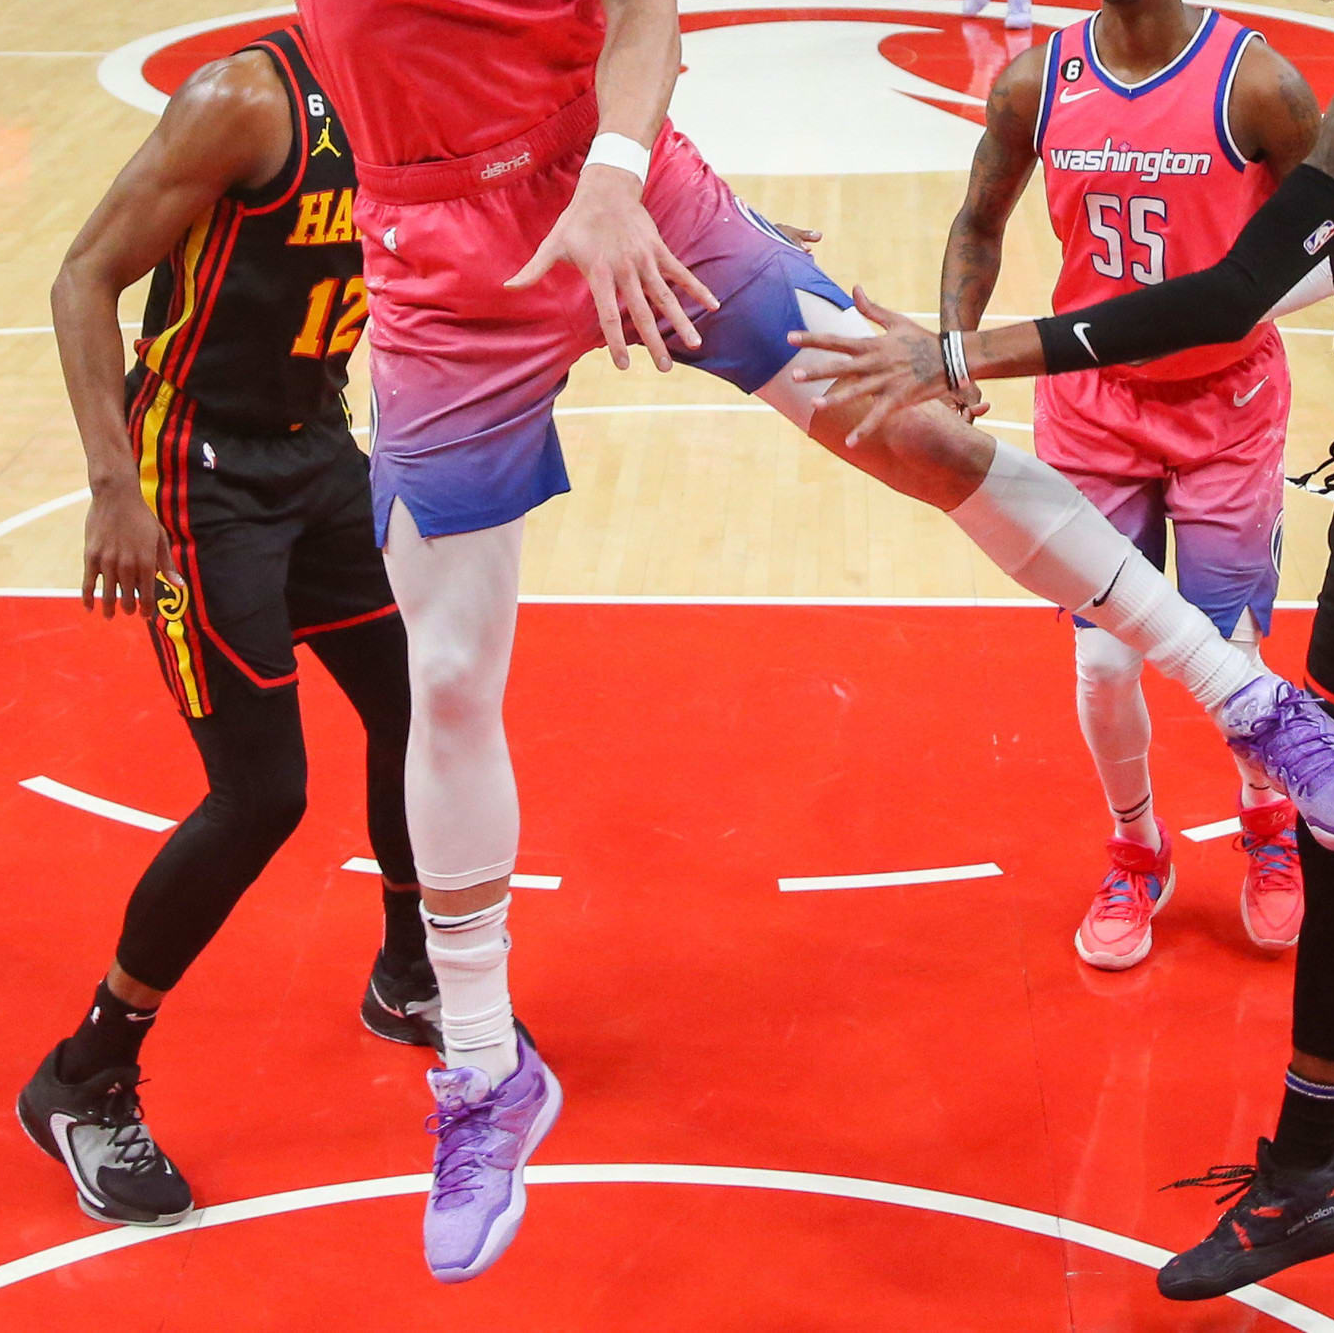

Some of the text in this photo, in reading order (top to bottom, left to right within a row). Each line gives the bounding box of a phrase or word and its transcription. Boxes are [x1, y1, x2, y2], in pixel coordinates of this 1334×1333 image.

[1064, 60, 1081, 82] 6
[307, 93, 326, 118] 6
[480, 151, 532, 180] district
[1050, 138, 1212, 182] washington
[1085, 192, 1168, 286] 55
[289, 275, 369, 360] 12
